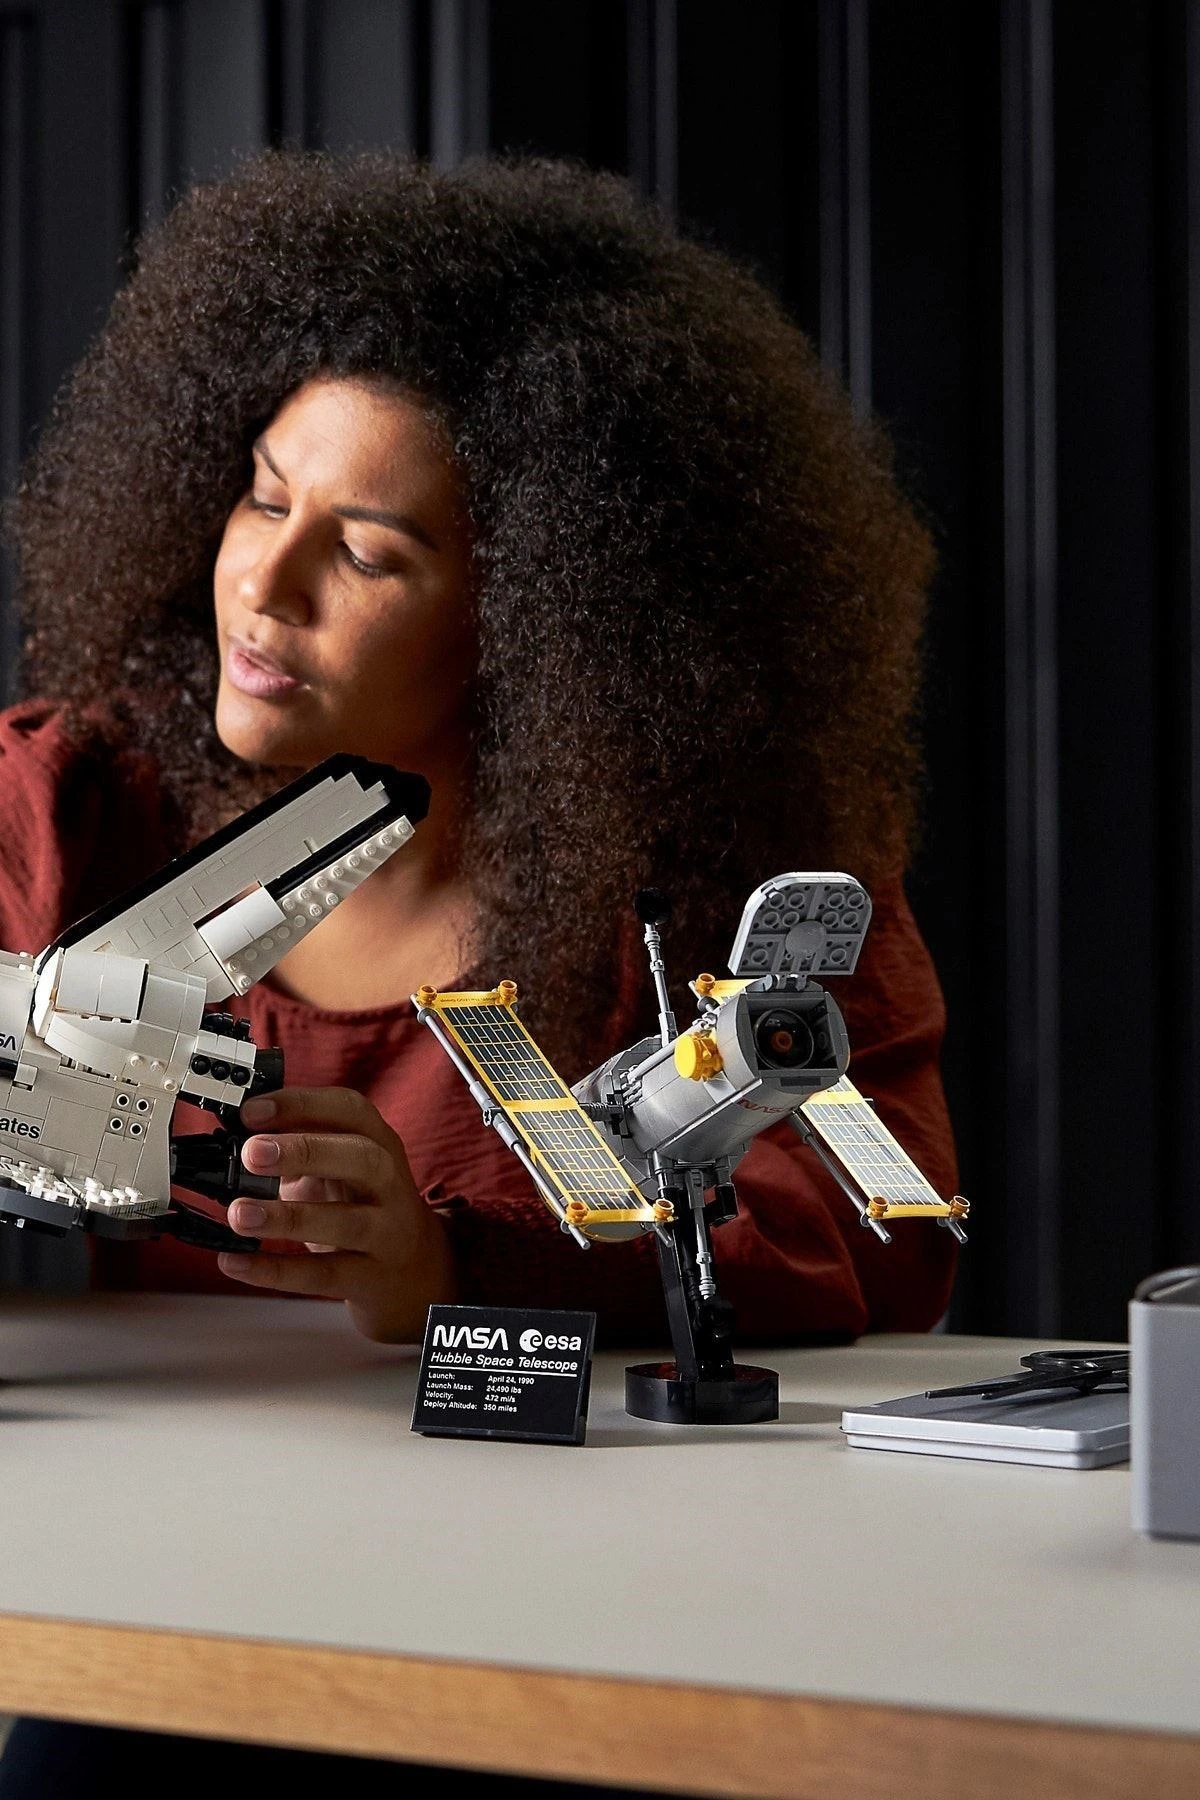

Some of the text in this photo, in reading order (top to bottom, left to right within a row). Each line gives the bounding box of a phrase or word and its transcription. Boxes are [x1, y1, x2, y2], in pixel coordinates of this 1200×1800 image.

[432, 1324, 509, 1351] NASA
[430, 1352, 578, 1373] Hubble Space Telescope
[428, 1372, 535, 1385] Launch: April 24, 1990
[426, 1381, 522, 1394] Launch Mass: 24,490 lbs
[425, 1391, 516, 1403] Velocity: 4.72 mi/s
[423, 1400, 517, 1412] Deploy Altitude: 350 miles
